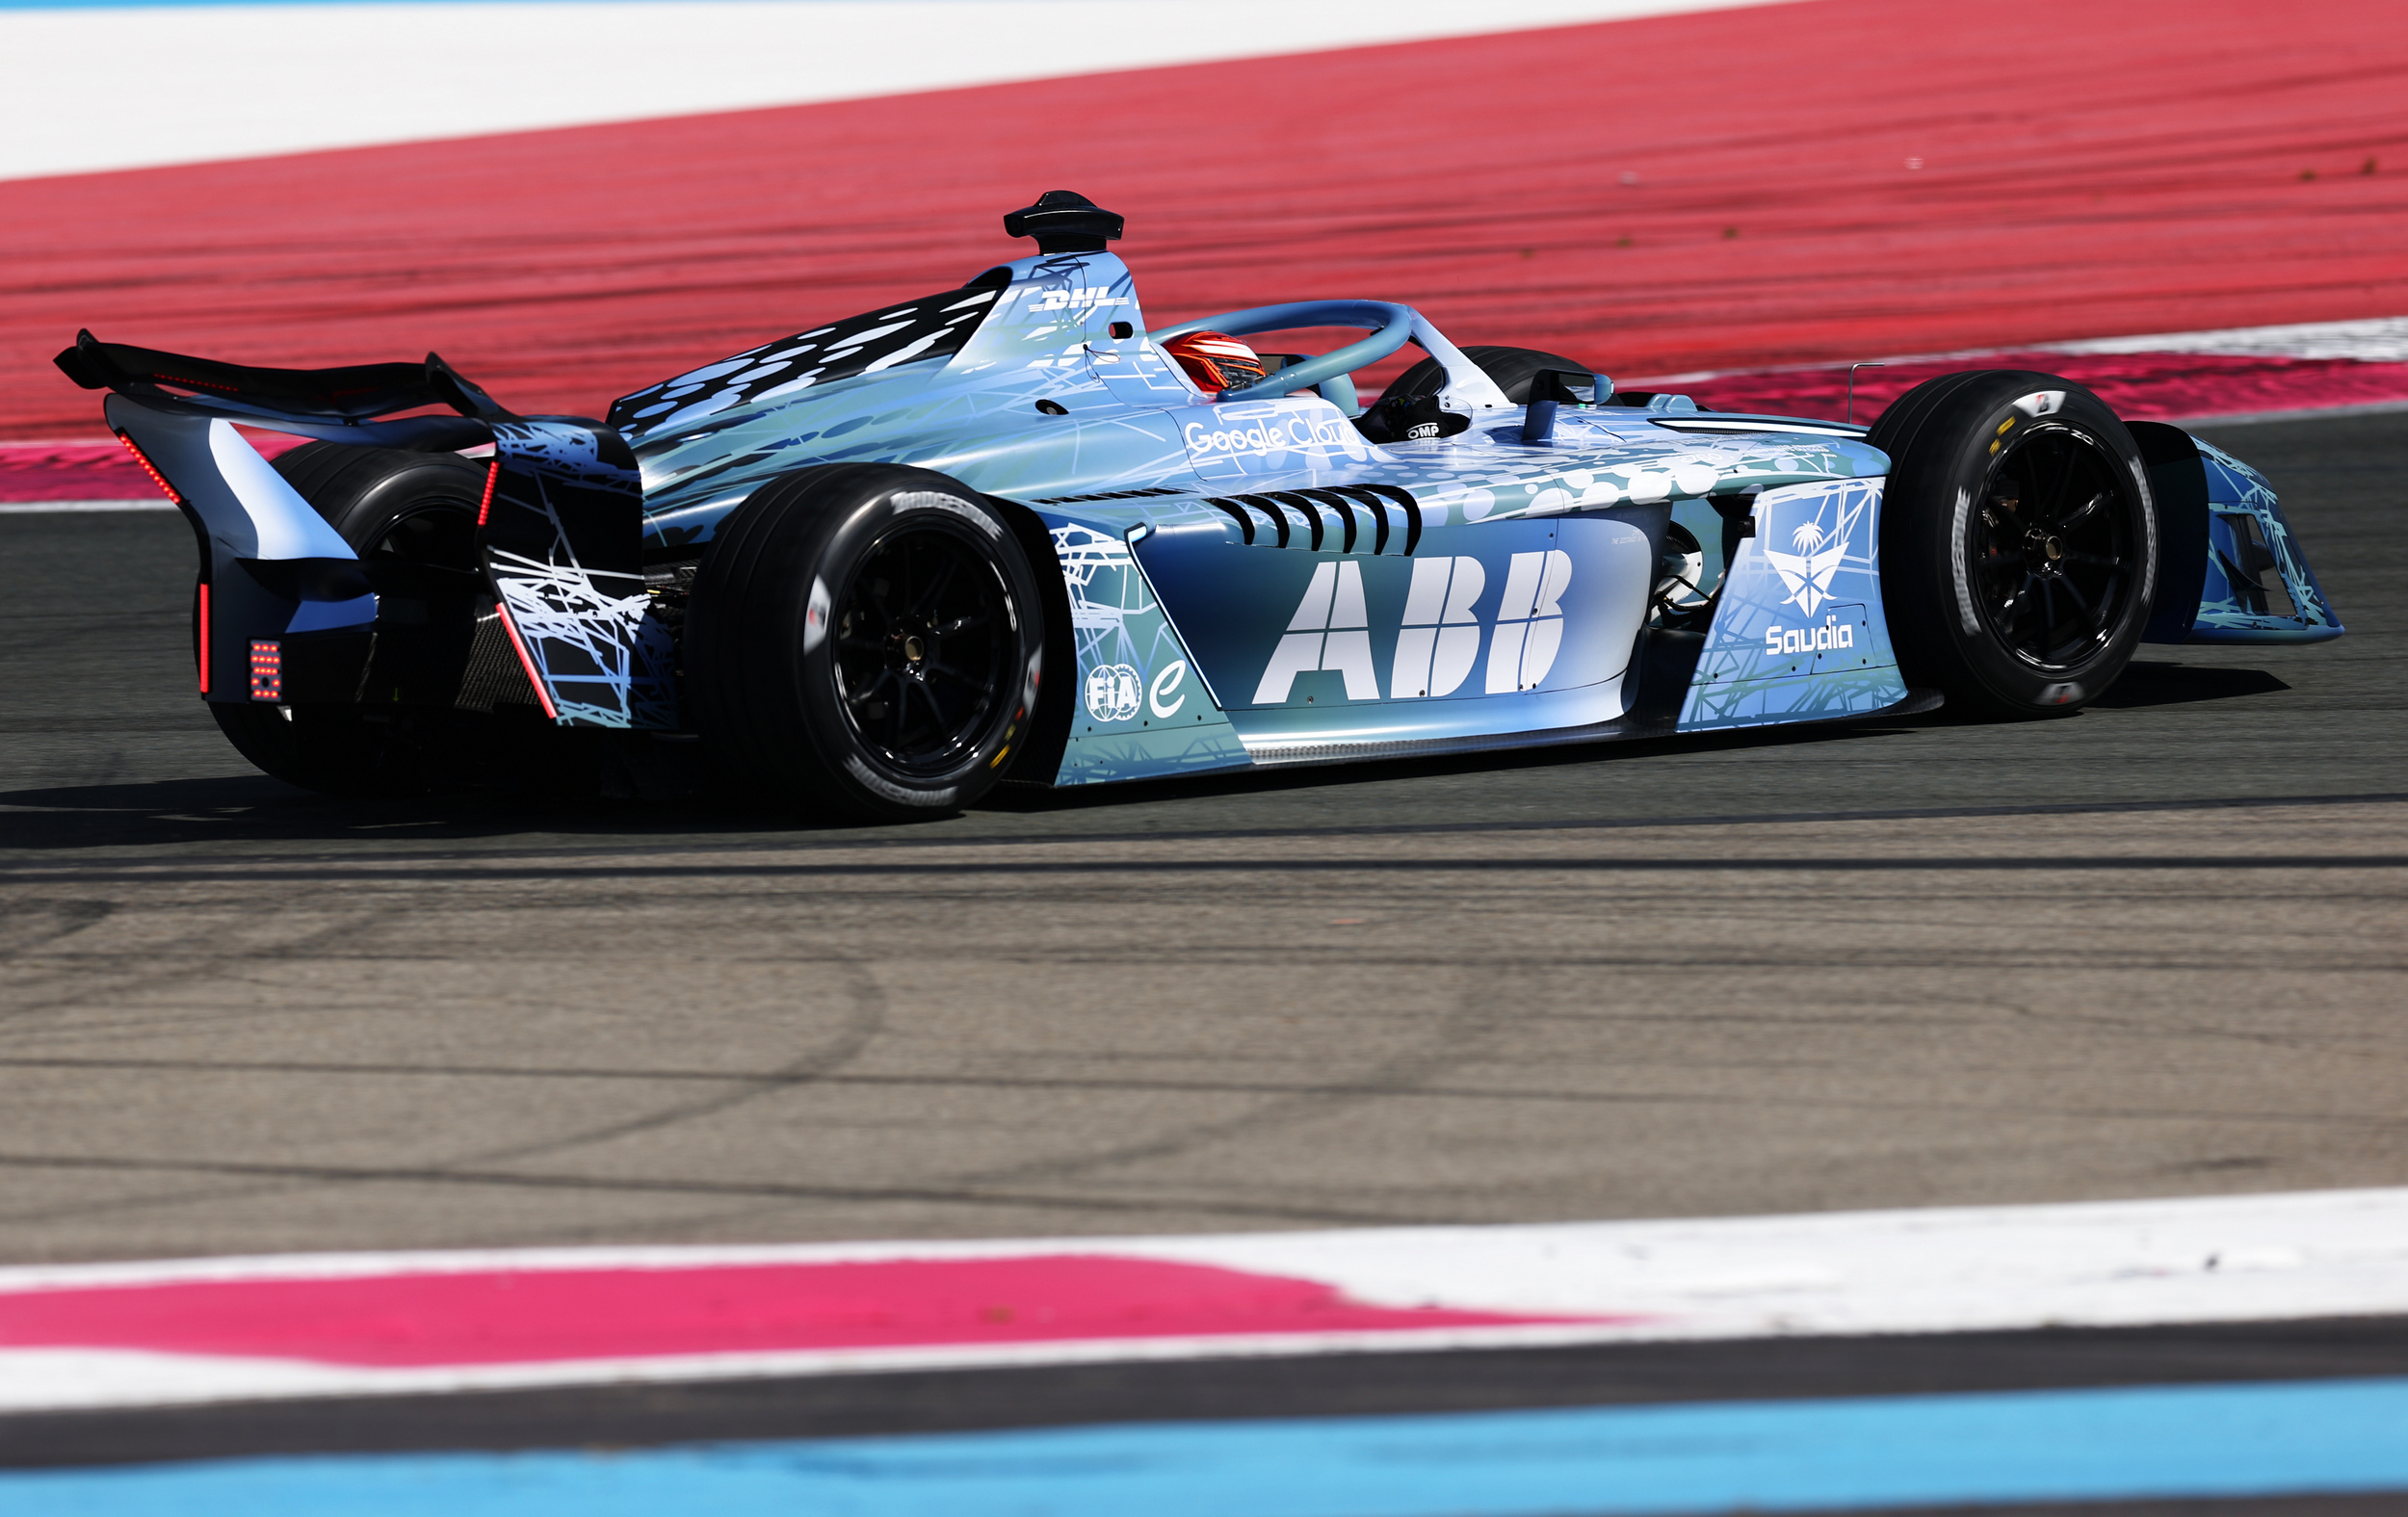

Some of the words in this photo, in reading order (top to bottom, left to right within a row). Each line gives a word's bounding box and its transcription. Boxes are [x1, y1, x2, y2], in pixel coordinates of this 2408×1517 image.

[1041, 286, 1116, 311] DHL
[1185, 419, 1286, 457] Google
[1288, 417, 1361, 446] Cloud
[1407, 424, 1440, 439] OMP
[1251, 549, 1573, 705] ABB
[1766, 615, 1853, 656] Saudia
